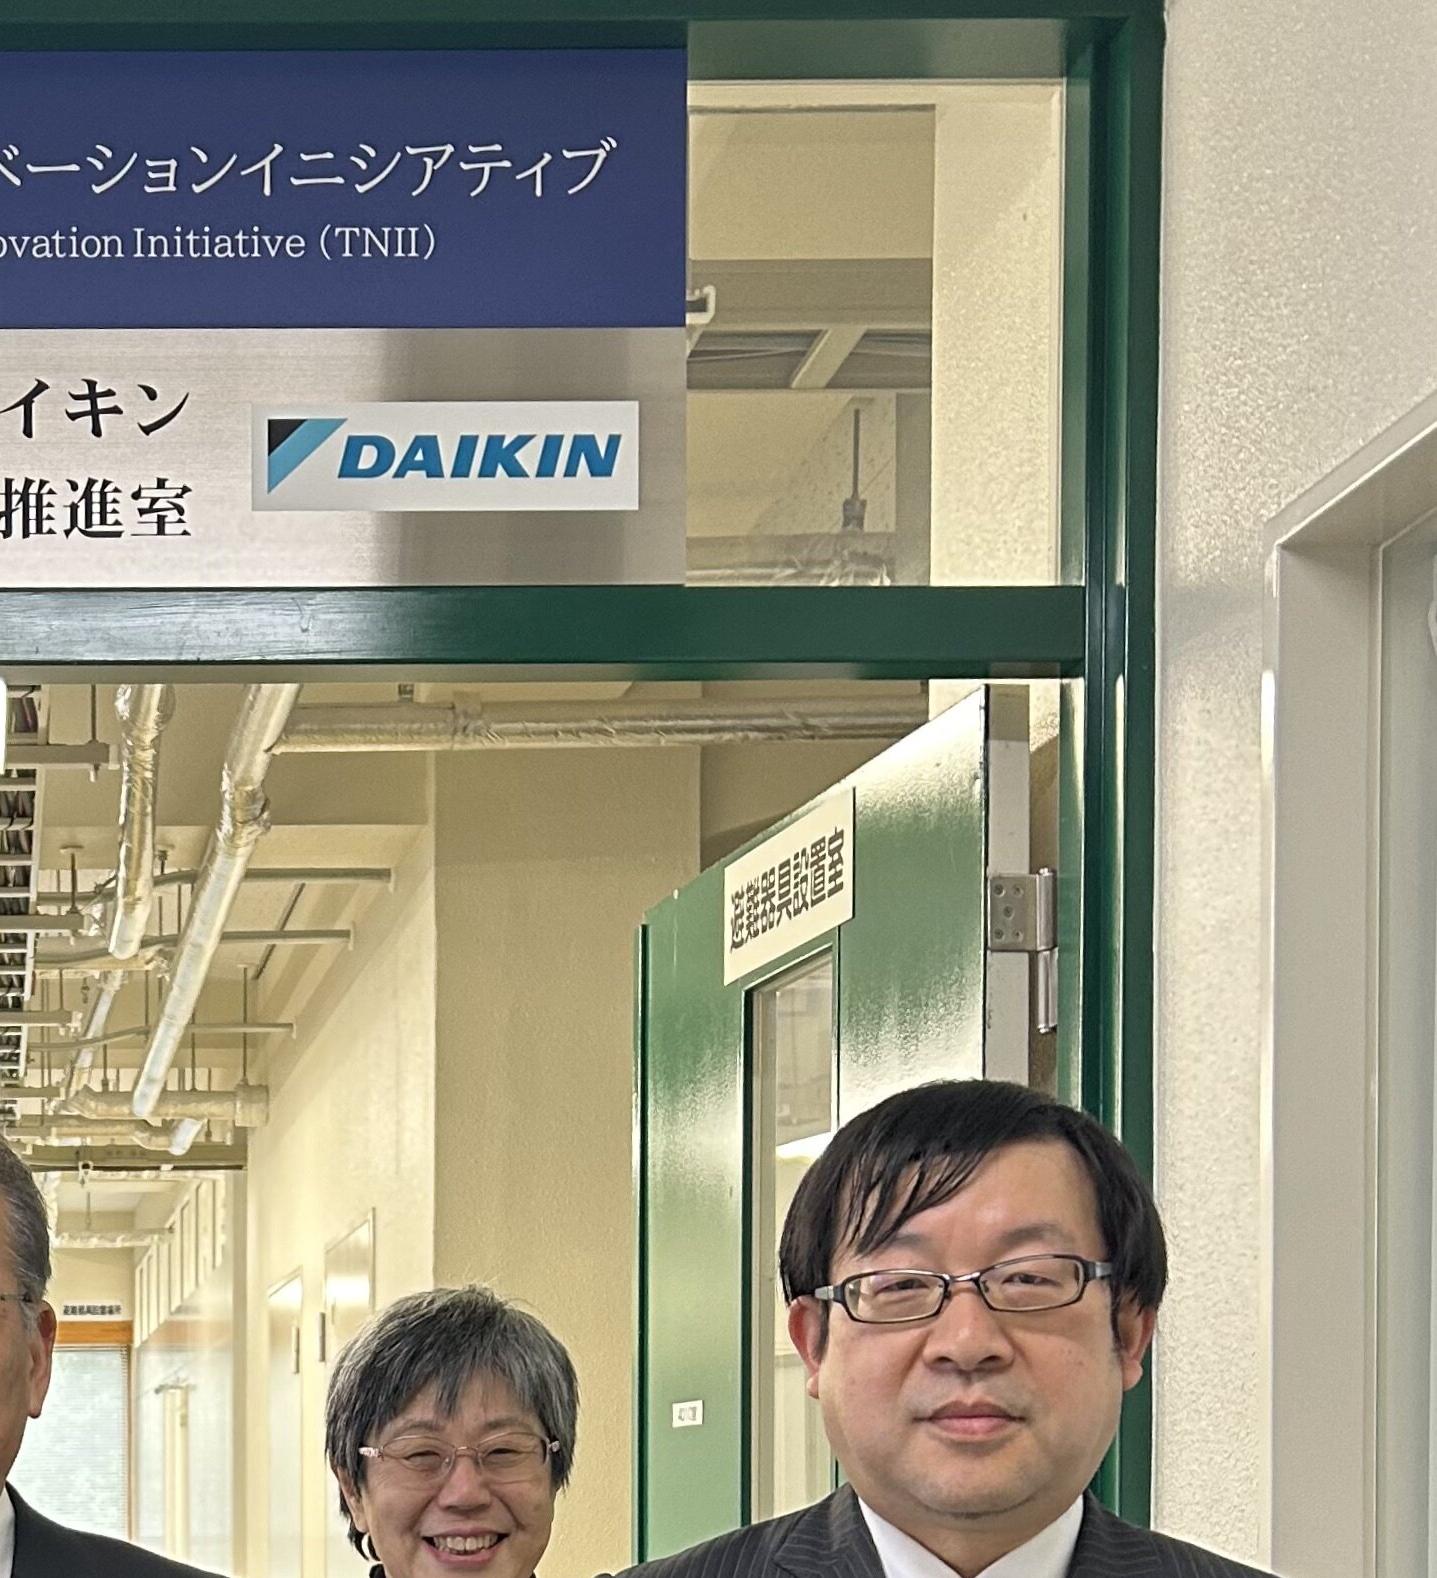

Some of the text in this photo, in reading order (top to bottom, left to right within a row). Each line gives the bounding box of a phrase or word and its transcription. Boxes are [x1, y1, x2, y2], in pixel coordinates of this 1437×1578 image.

[133, 224, 306, 260] Initiative
[319, 224, 436, 262] (TNII)
[336, 433, 623, 479] DAIKIN
[729, 825, 845, 953] 避難器具設置室
